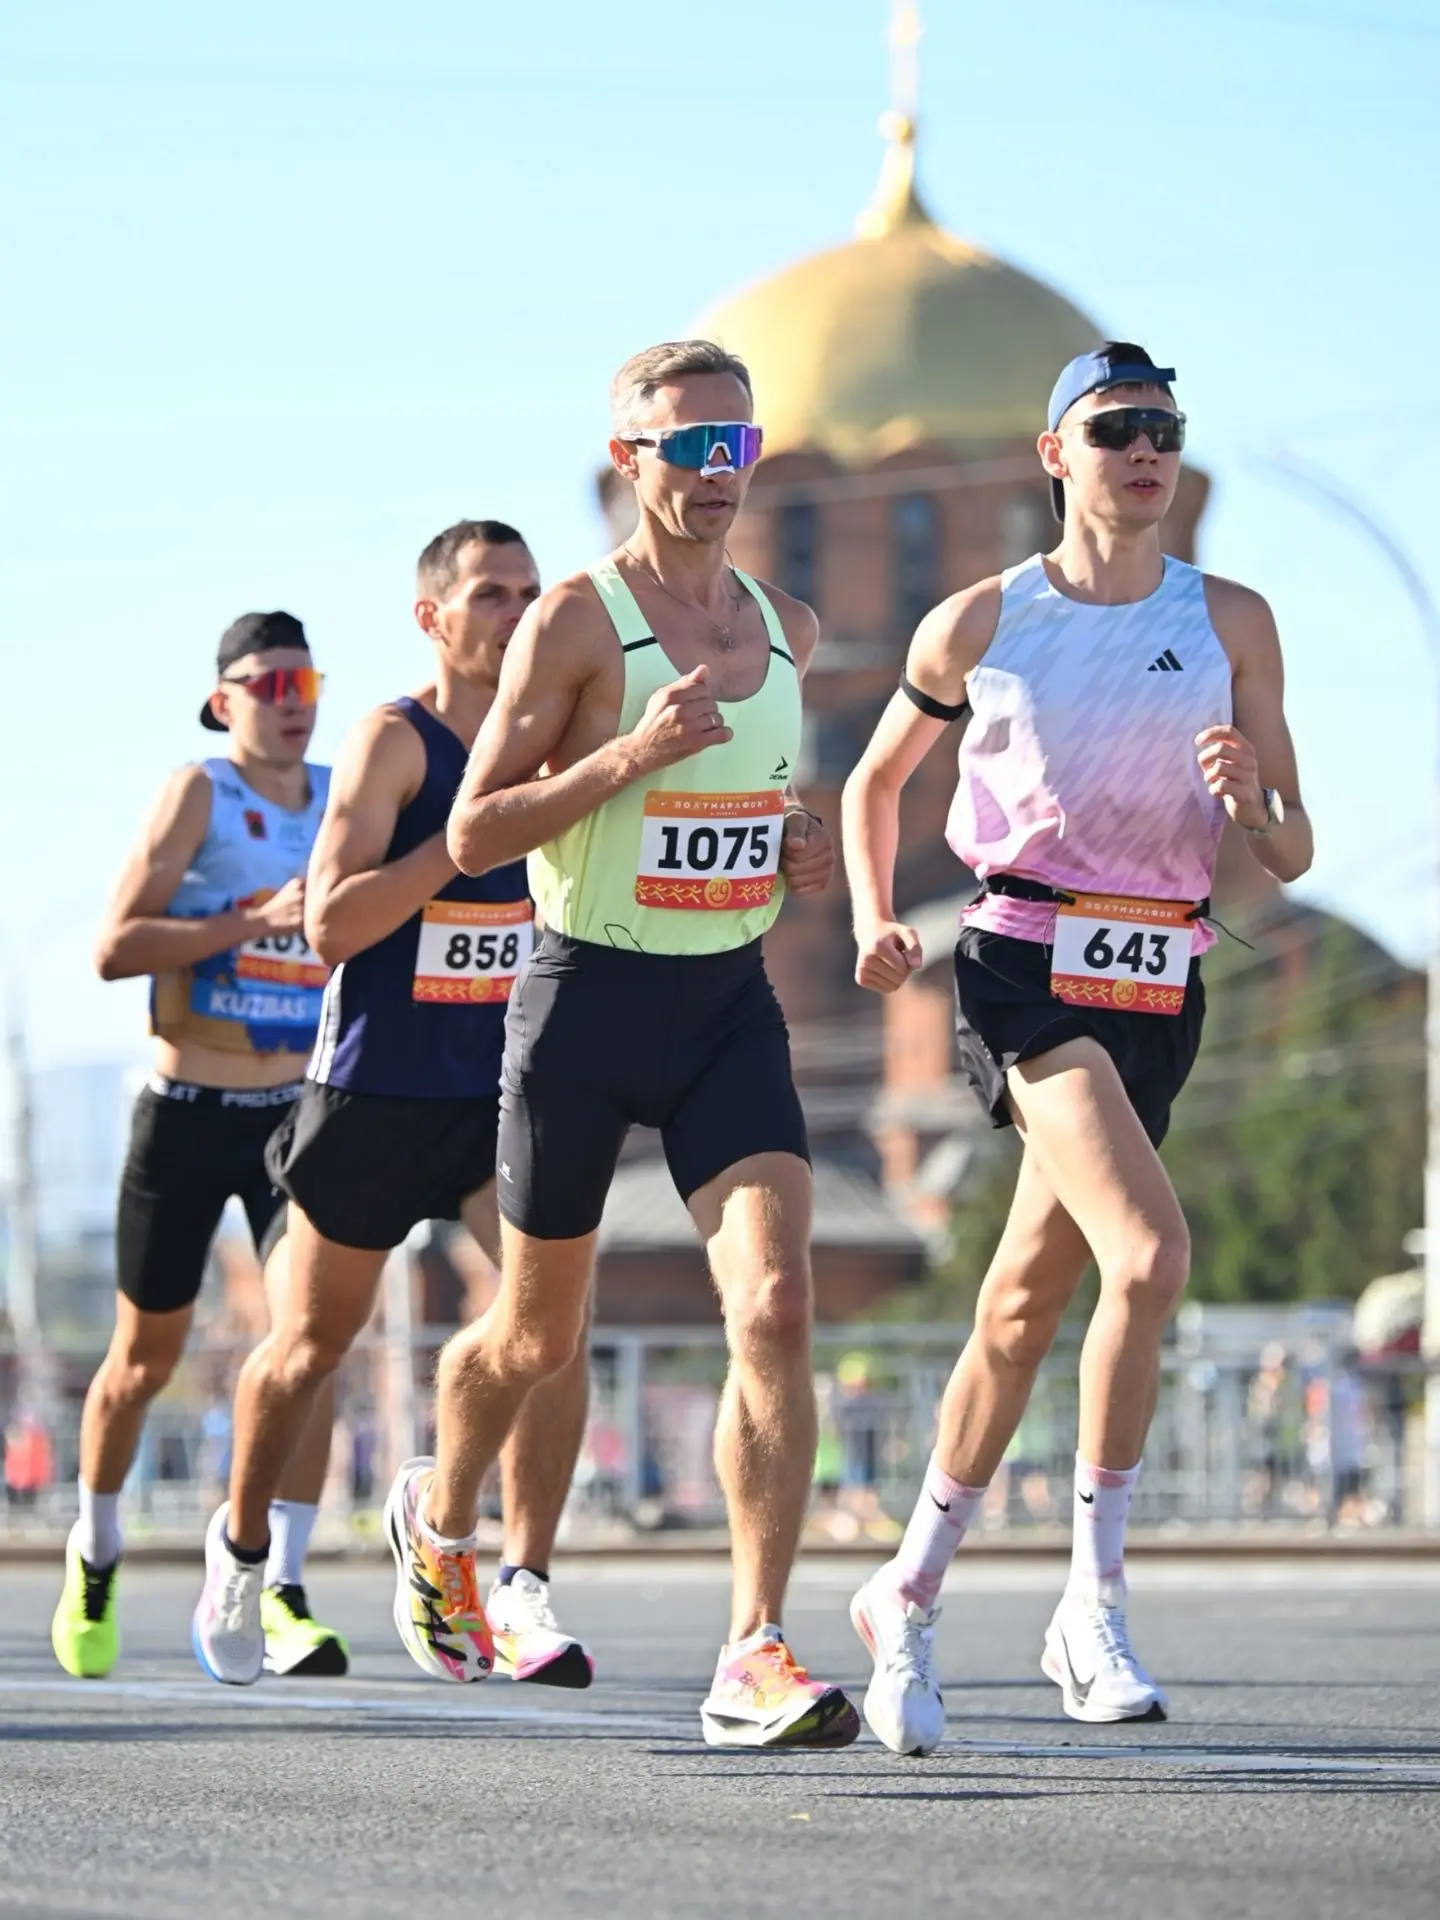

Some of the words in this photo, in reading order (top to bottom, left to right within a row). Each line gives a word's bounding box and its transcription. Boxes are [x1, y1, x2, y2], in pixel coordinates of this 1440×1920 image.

[658, 825, 769, 870] 1075
[445, 933, 518, 970] 858
[1084, 928, 1170, 976] 643
